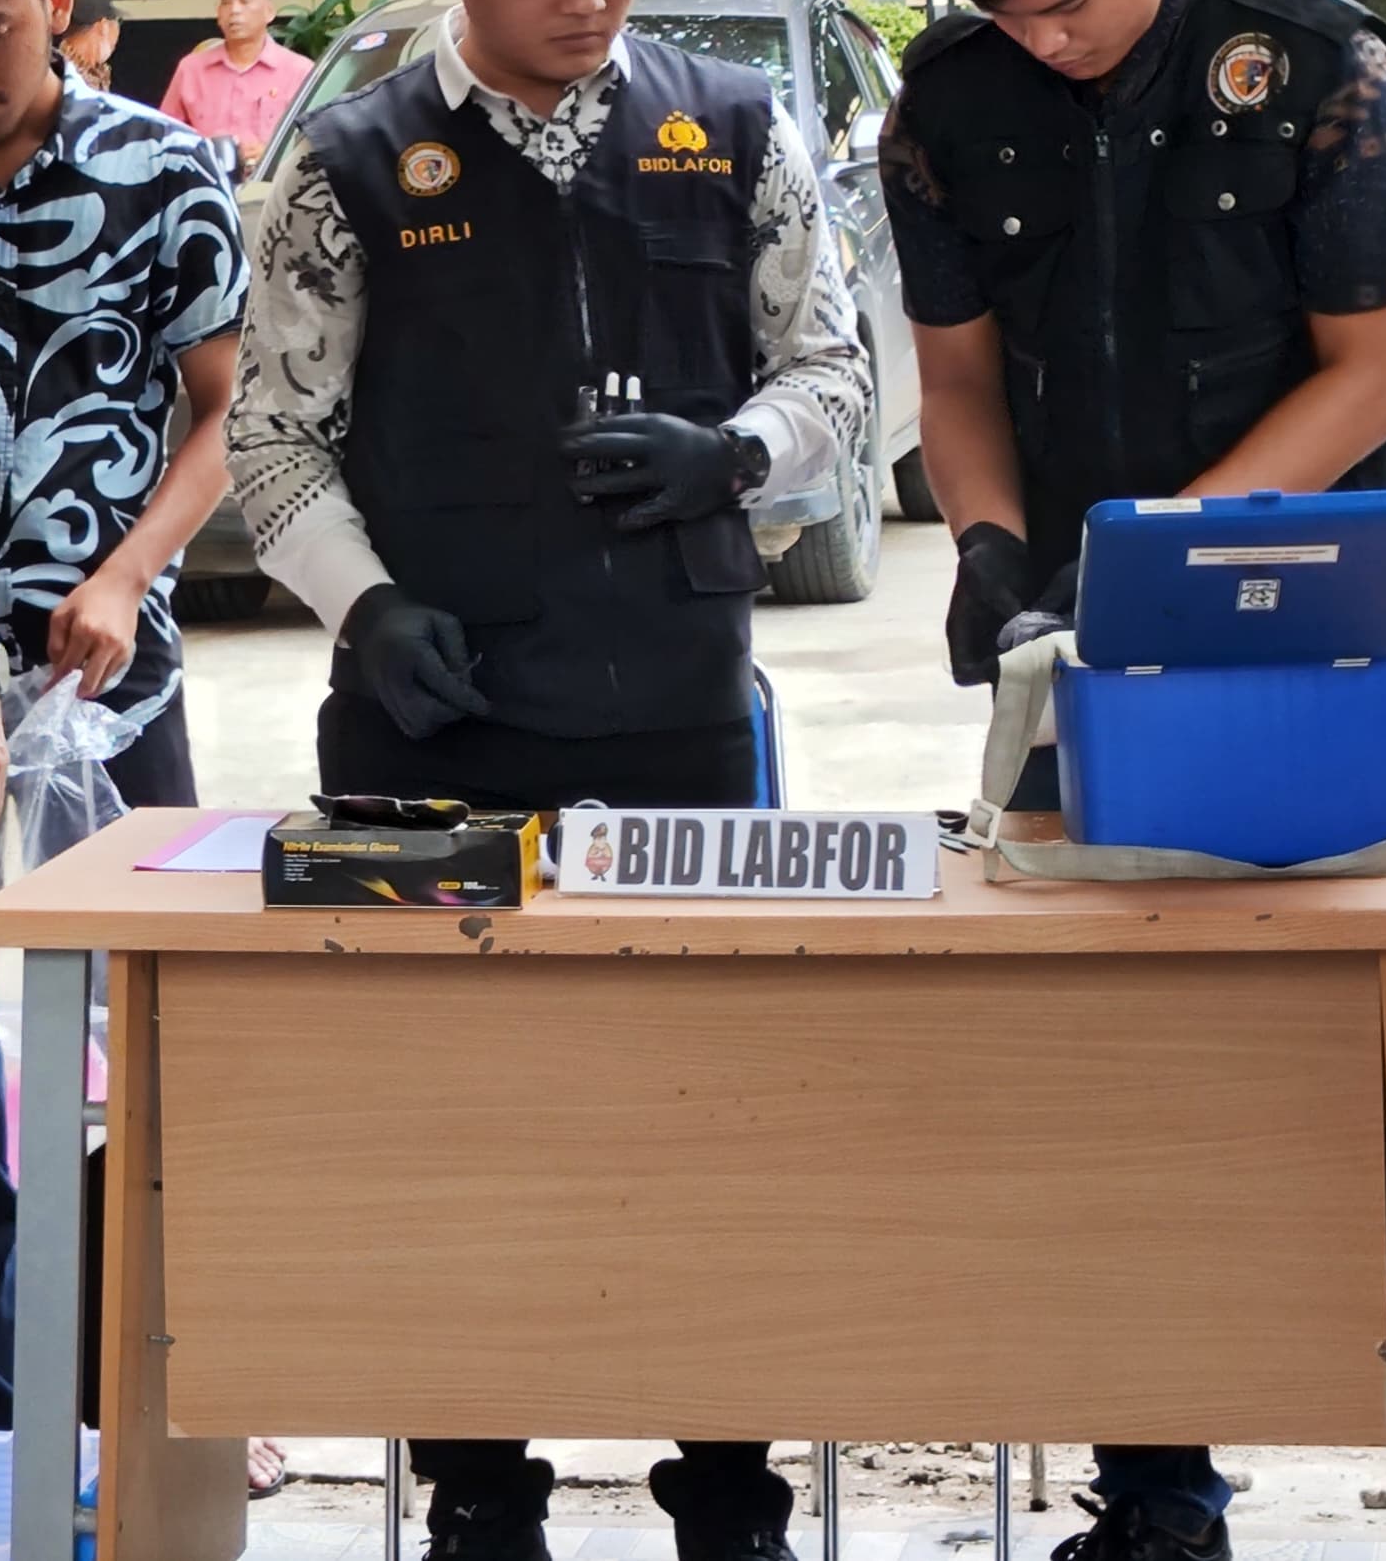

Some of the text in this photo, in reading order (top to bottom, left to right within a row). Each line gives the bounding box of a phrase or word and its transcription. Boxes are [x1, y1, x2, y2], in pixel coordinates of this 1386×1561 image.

[637, 157, 733, 175] BIDLAFOR
[399, 221, 471, 249] DIRLI
[616, 816, 907, 892] BID LABFOR
